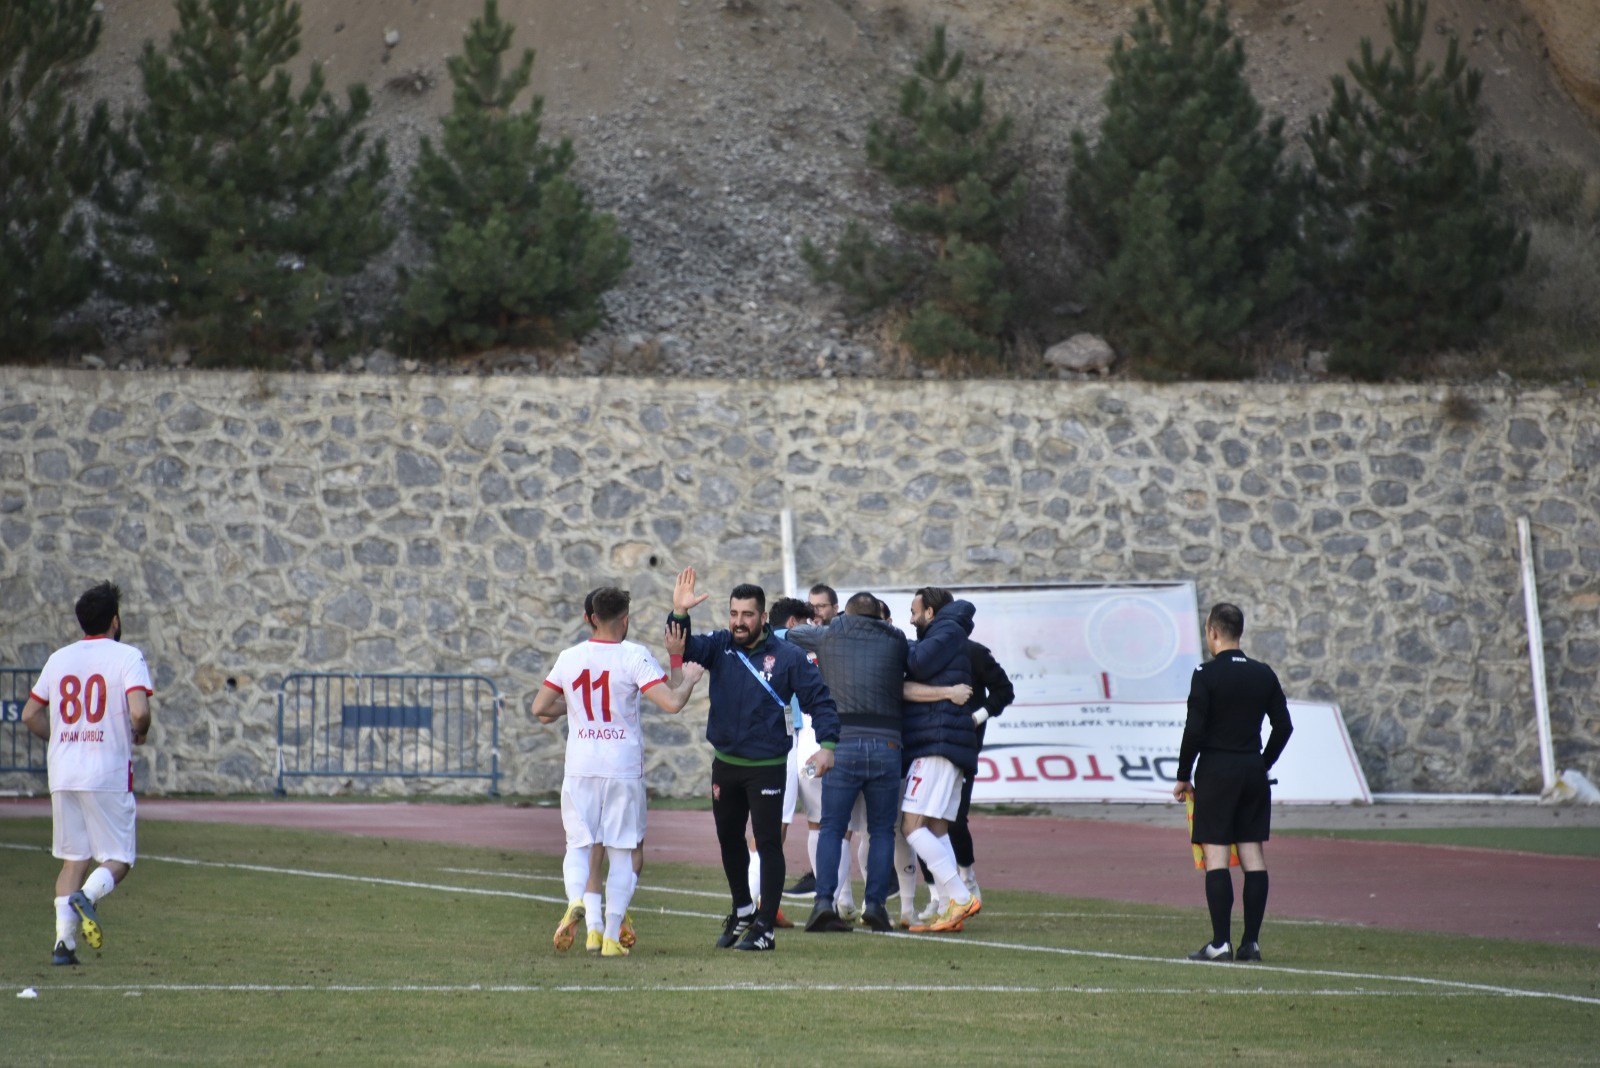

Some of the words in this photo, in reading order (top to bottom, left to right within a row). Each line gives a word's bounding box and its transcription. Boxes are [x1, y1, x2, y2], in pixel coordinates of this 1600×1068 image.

[59, 673, 106, 724] 80
[572, 669, 611, 722] 11
[60, 731, 79, 743] AYAN
[80, 728, 104, 742] ÜRBÜZ
[1107, 720, 1187, 728] TKILARIYLA
[974, 755, 1114, 782] TOTO
[1117, 755, 1179, 781] OR
